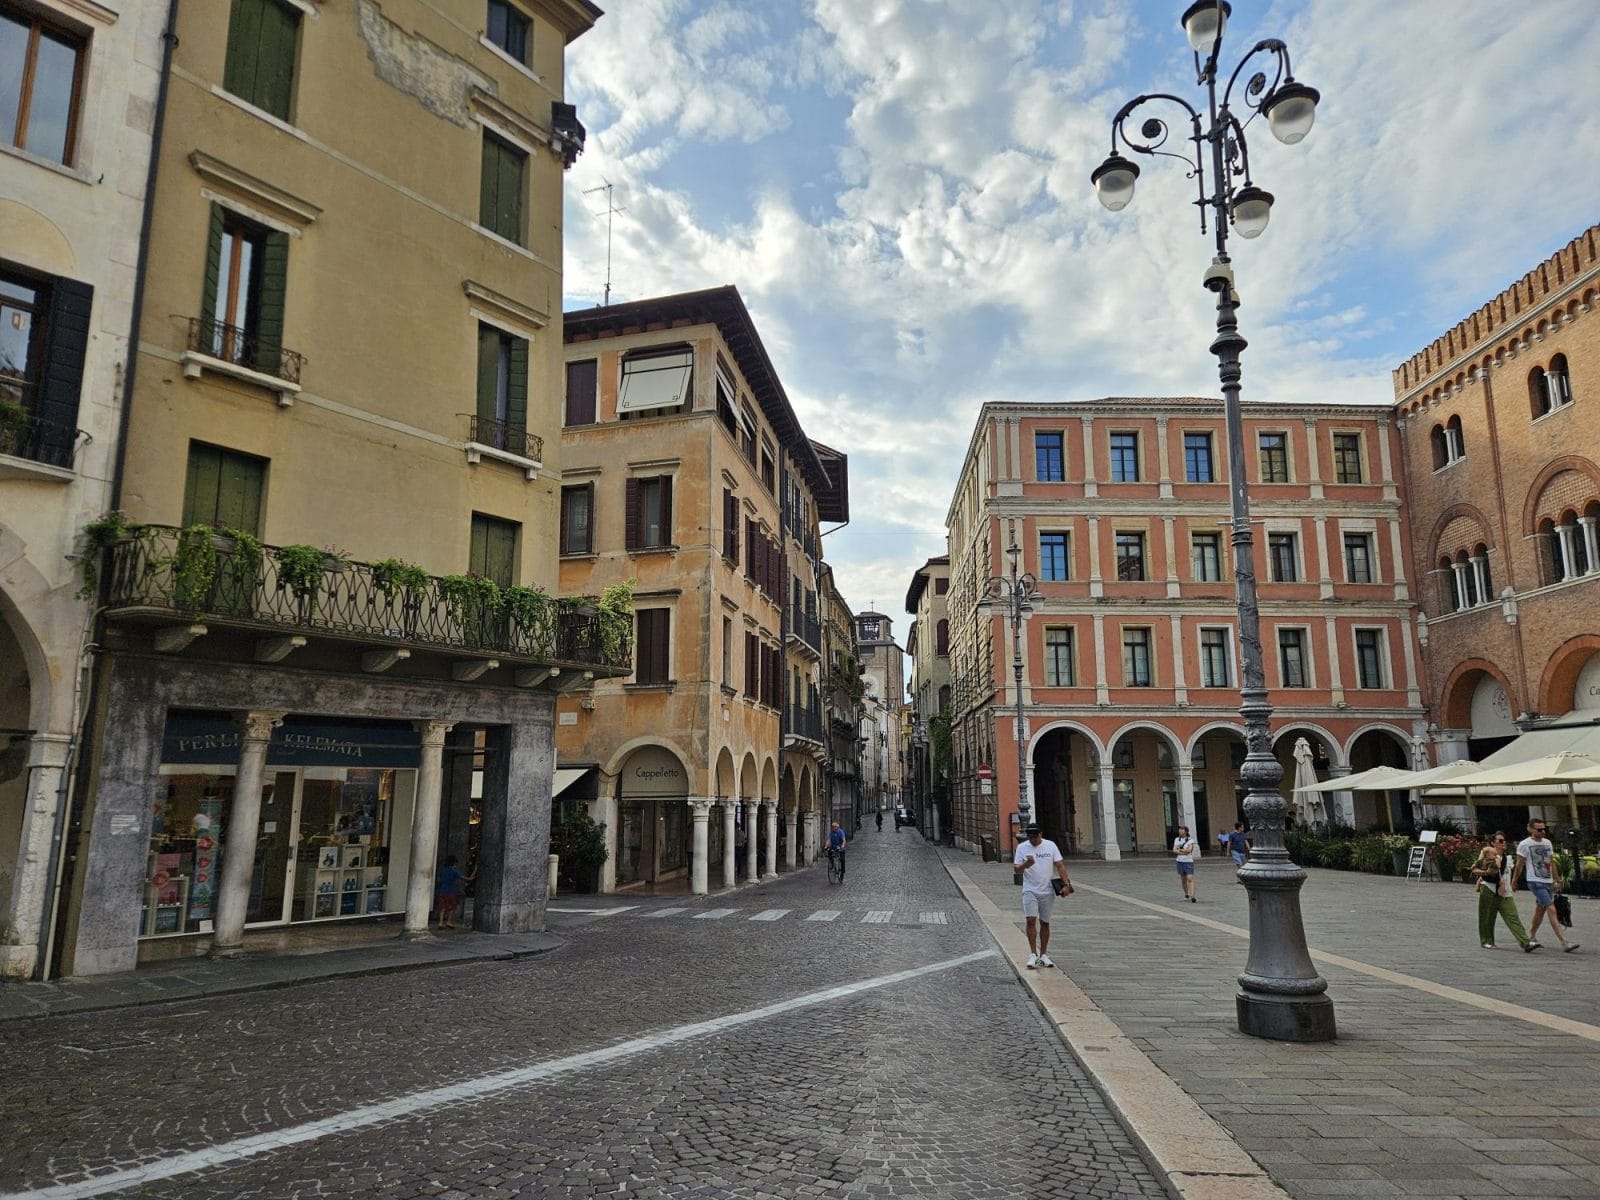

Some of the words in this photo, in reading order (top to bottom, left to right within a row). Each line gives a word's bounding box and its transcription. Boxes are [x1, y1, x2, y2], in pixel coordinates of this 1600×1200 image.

[178, 732, 240, 752] PERLI
[284, 733, 363, 758] KELEMATA
[635, 766, 680, 781] Cappelletto
